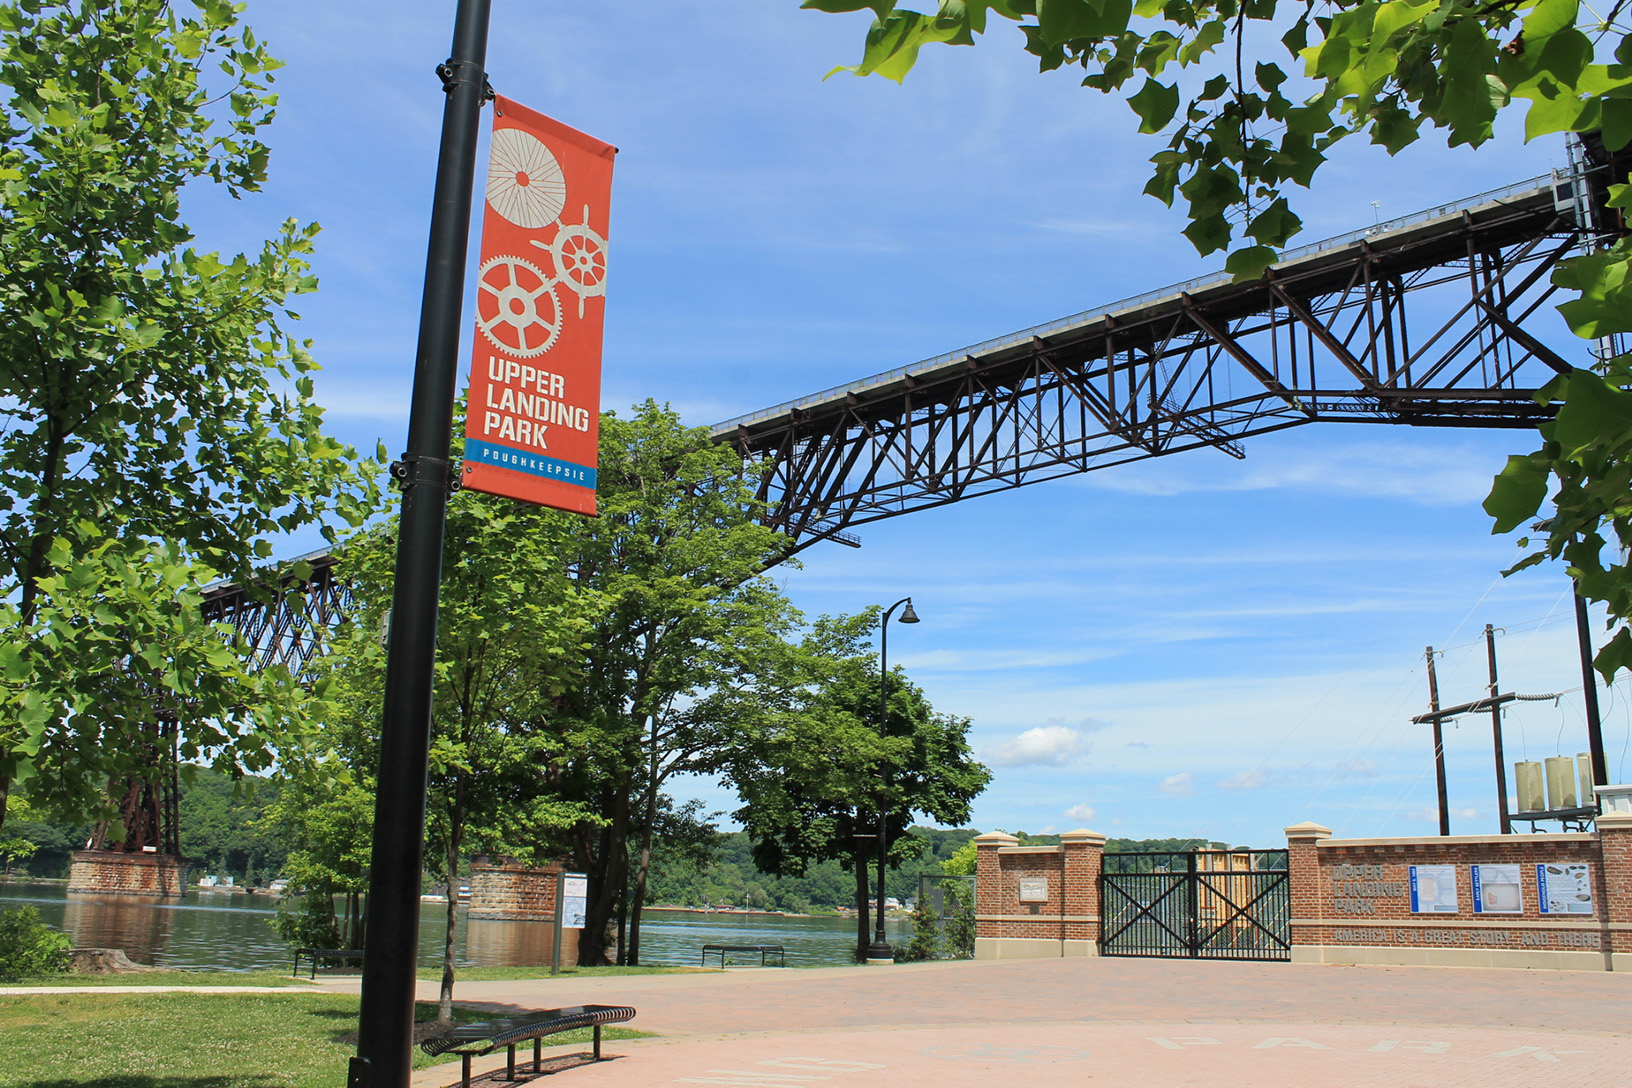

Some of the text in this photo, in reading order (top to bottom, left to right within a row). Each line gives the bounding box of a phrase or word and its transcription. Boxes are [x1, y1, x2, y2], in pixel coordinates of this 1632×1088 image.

[488, 356, 565, 399] UPPER
[486, 383, 589, 432] LANDING
[484, 411, 548, 449] PARK
[483, 448, 585, 481] POUGHKEEPSIE
[1332, 864, 1384, 881] UPPER
[1333, 881, 1404, 897] LANDING
[1334, 898, 1376, 914] PARK
[1335, 929, 1601, 947] AMERICA IS A GREAT STORY, AND THERE
[1146, 1036, 1597, 1063] PARK
